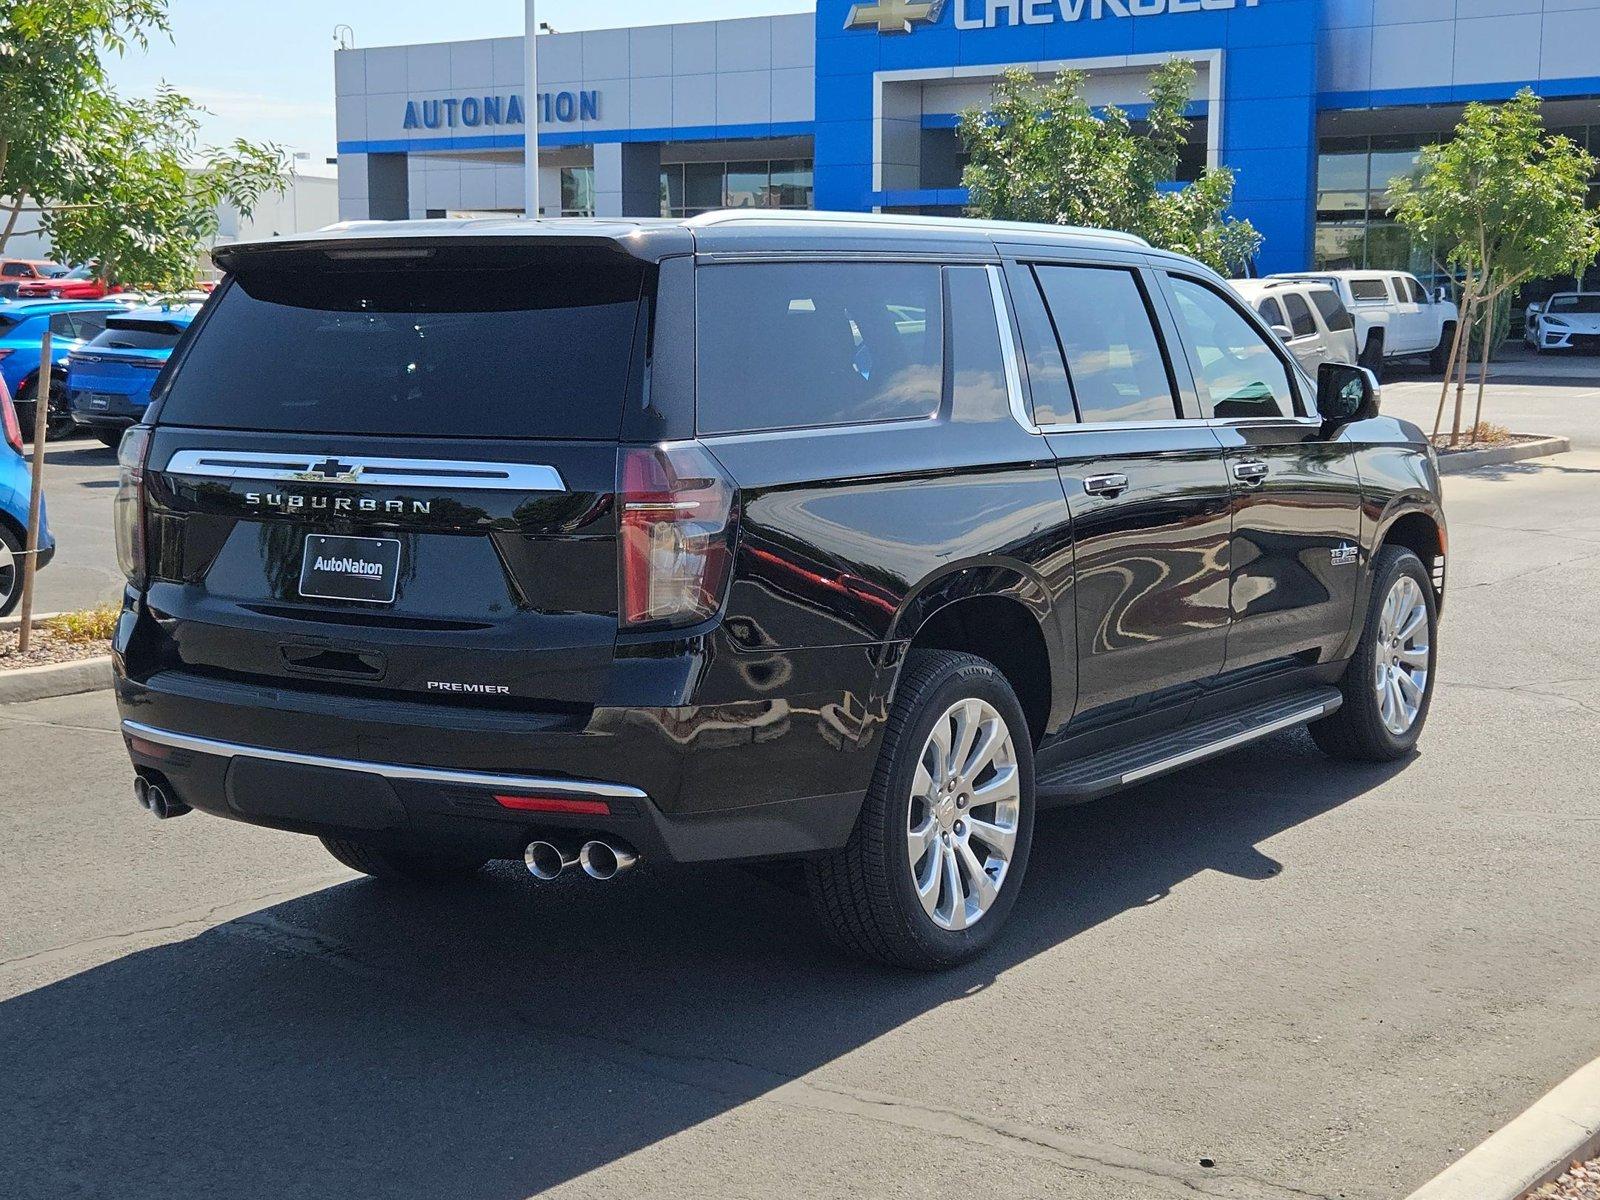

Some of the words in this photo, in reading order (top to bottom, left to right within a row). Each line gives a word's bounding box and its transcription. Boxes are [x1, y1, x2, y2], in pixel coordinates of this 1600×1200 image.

[953, 0, 1259, 30] CHEVR
[403, 90, 597, 129] AUTONAION
[245, 492, 431, 514] SUBURBAN
[314, 556, 383, 575] AutoNation
[427, 681, 511, 695] PREMIER
